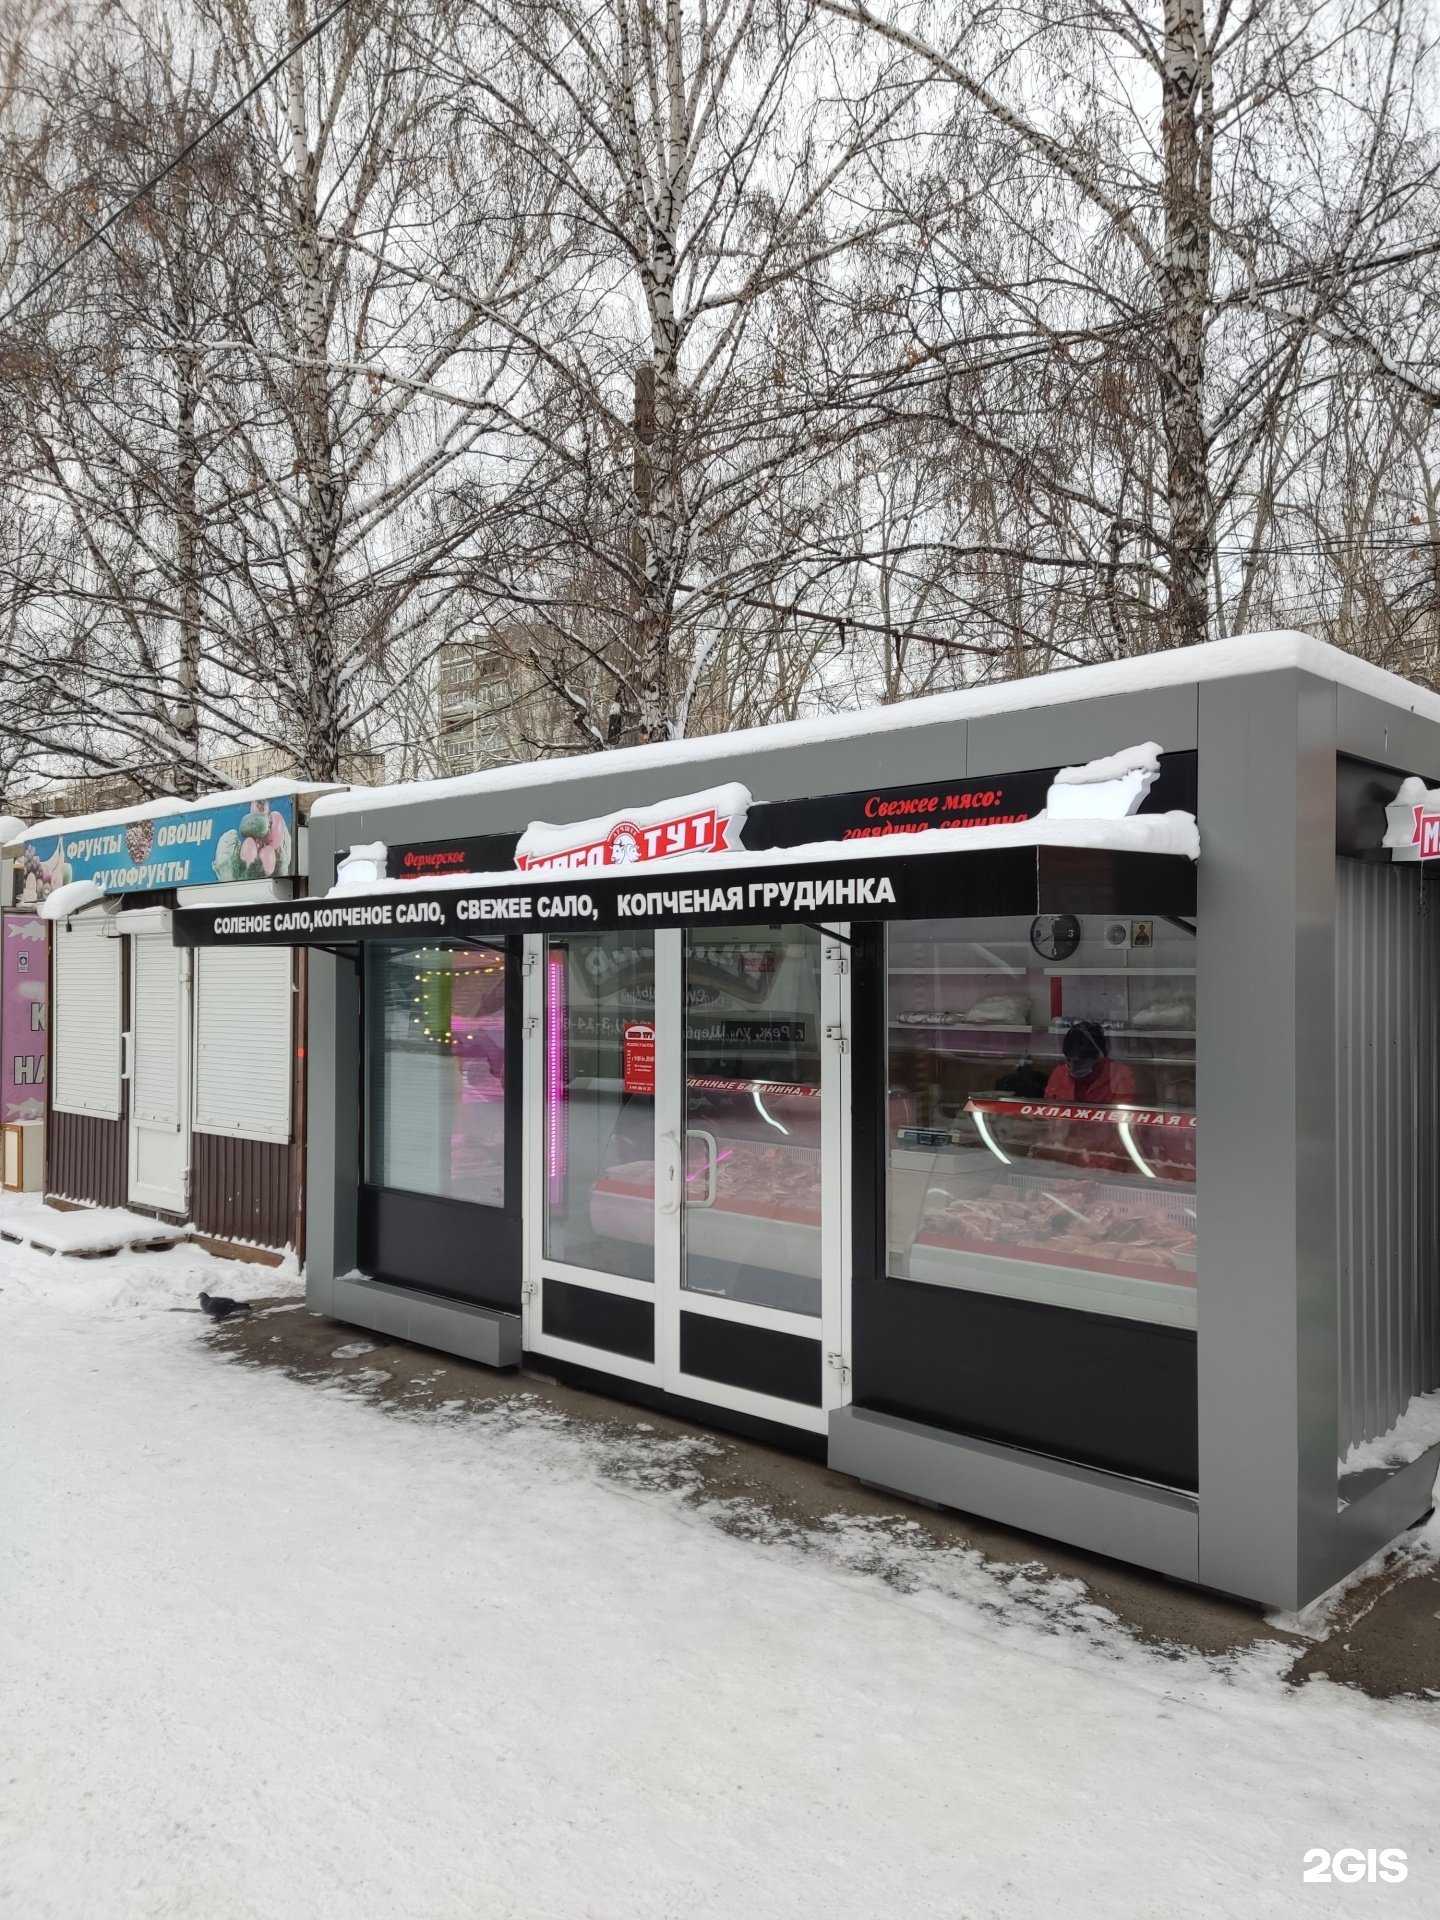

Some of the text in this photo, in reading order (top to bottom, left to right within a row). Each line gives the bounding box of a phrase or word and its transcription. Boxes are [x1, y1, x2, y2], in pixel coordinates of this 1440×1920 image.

[865, 790, 1003, 818] Свежее мясо:
[157, 819, 213, 847] ОВОЩИ
[644, 815, 711, 859] ТУТ
[214, 915, 271, 934] СОЛЕНОЕ
[395, 901, 446, 925] САЛО,
[456, 897, 533, 920] СВЕЖЕЕ
[537, 894, 599, 921] САЛО,
[617, 886, 743, 917] КОПЧЕНАЯ
[748, 877, 896, 911] ГРУДИНКА
